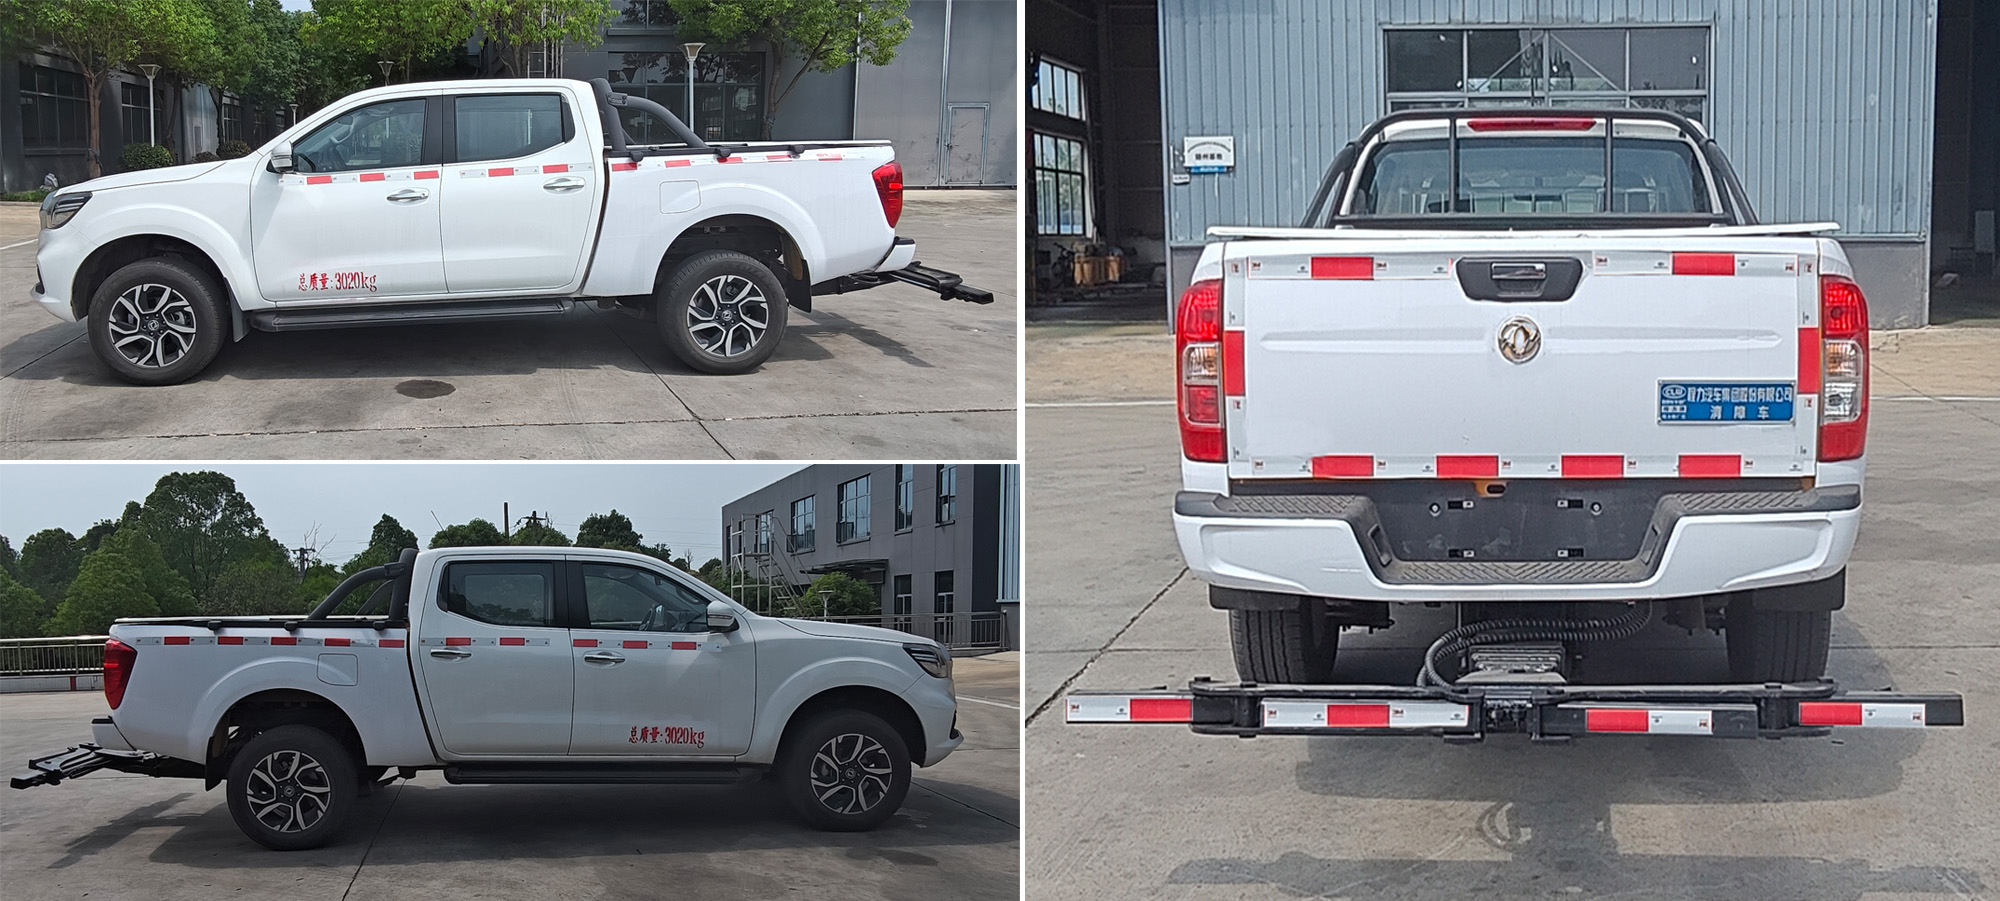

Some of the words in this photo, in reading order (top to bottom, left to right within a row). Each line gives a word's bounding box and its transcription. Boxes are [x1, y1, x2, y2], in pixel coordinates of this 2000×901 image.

[298, 271, 378, 293] 总质量:3020kg
[1687, 387, 1793, 403] 程力汽车集团股份有限公司
[1710, 405, 1769, 419] 清障车
[629, 725, 705, 749] 总质量:3020kg
